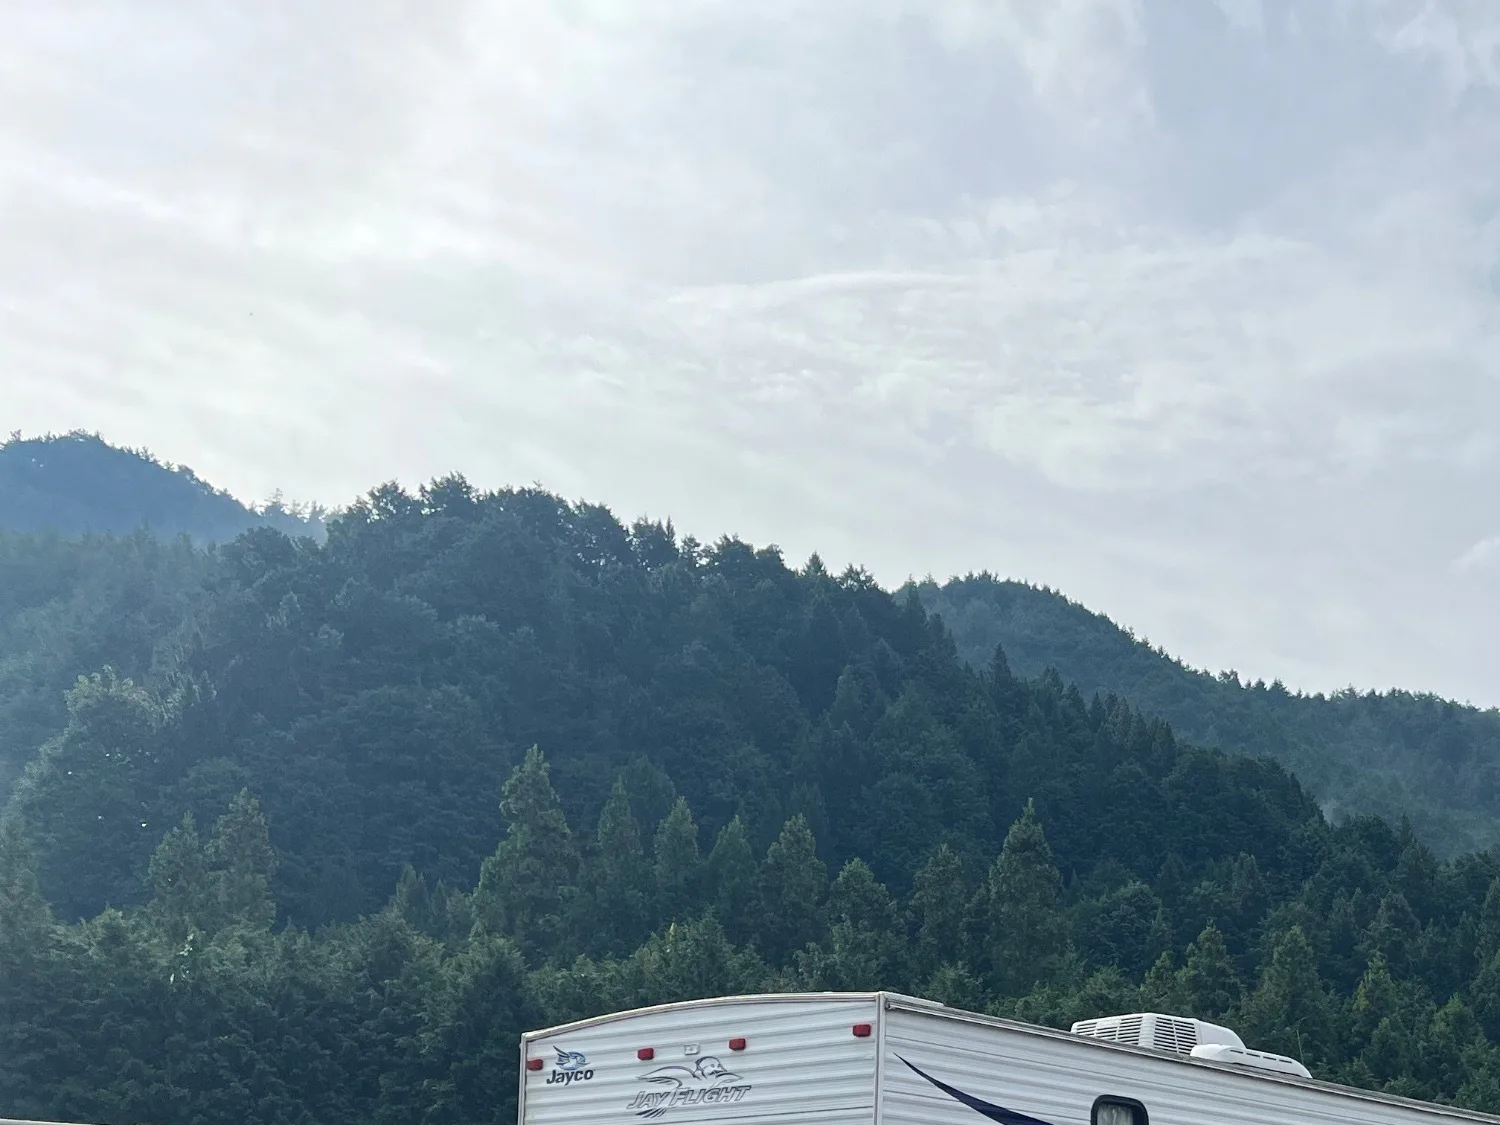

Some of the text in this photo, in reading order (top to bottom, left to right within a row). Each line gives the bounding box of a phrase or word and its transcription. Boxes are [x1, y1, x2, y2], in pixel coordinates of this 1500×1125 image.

[546, 1069, 594, 1086] Jayco
[627, 1085, 752, 1109] JAY FLIGHT
